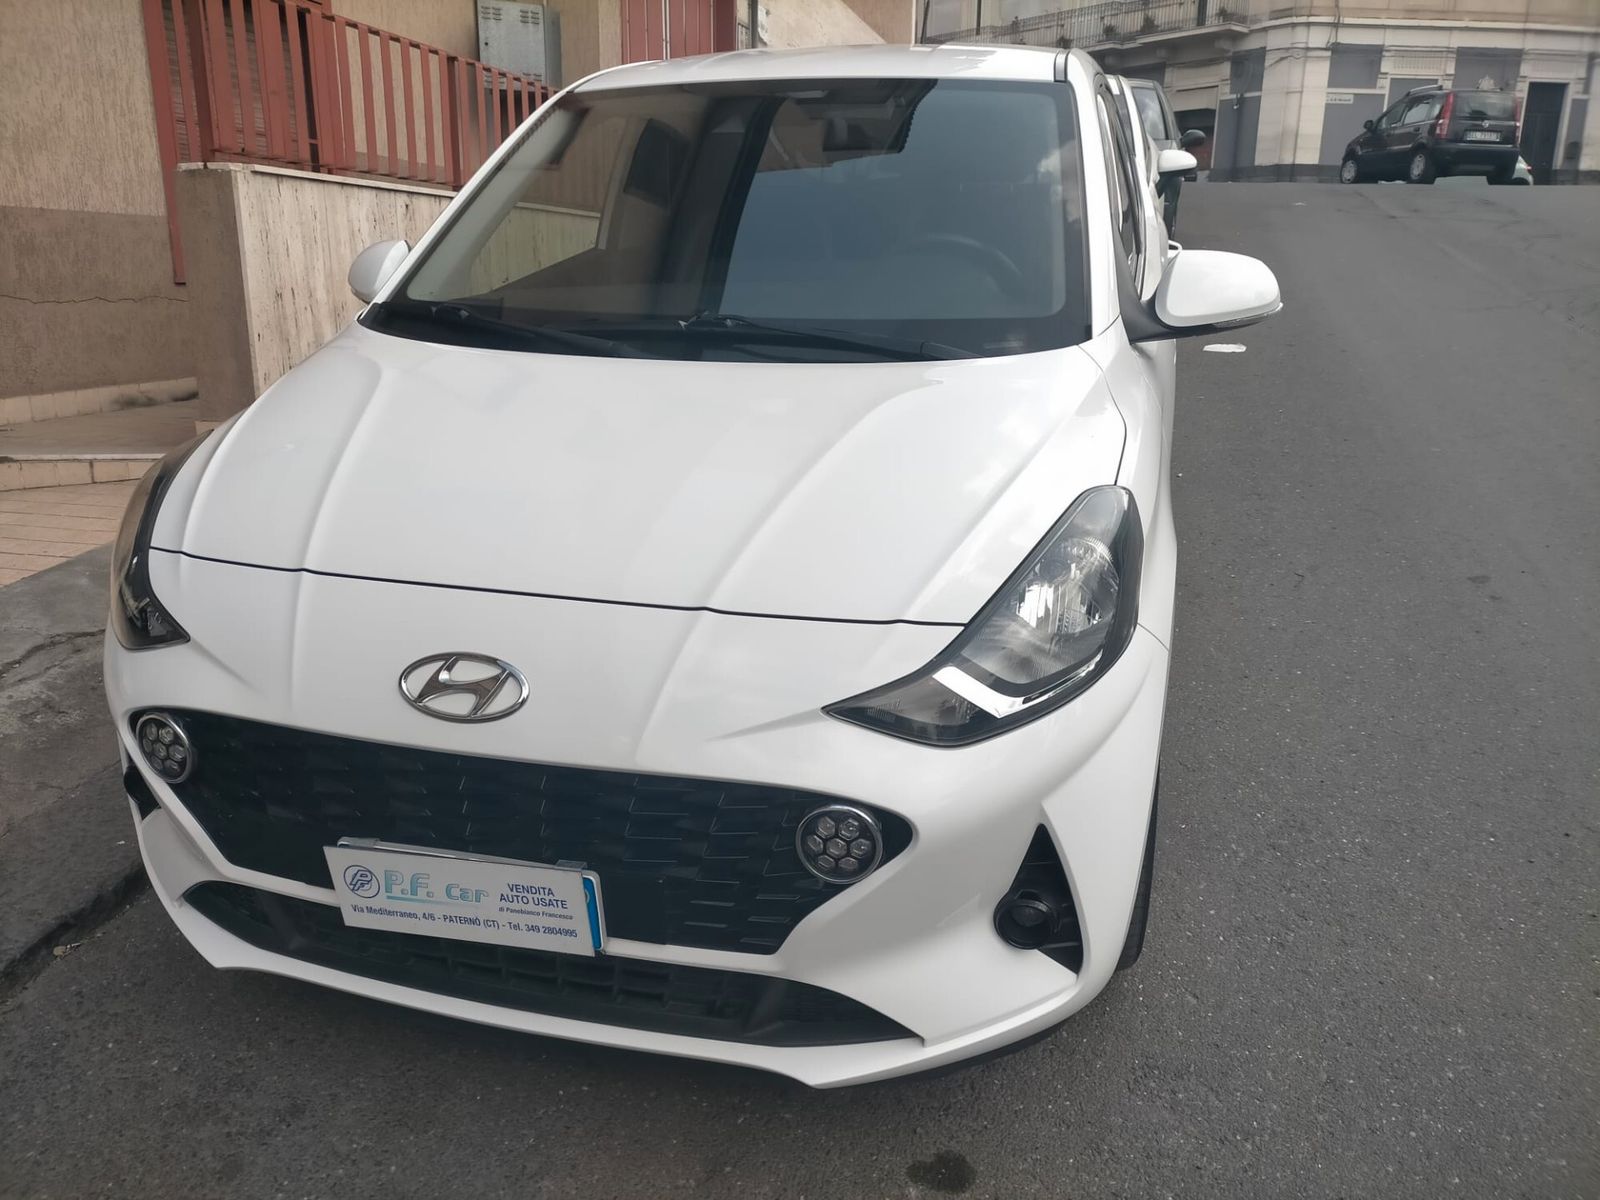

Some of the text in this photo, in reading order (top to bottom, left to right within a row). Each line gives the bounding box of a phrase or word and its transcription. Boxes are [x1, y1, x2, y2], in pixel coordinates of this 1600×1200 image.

[384, 869, 489, 903] P.F. Car
[507, 883, 555, 897] VENDITA
[499, 893, 568, 909] AUTO USATE
[351, 904, 365, 913] Via
[365, 905, 421, 921] Mediterraneo,
[422, 912, 436, 921] 4/6
[483, 919, 500, 930] (CT)
[507, 921, 523, 931] Tel.
[525, 924, 540, 933] 349
[543, 926, 578, 938] 2804995
